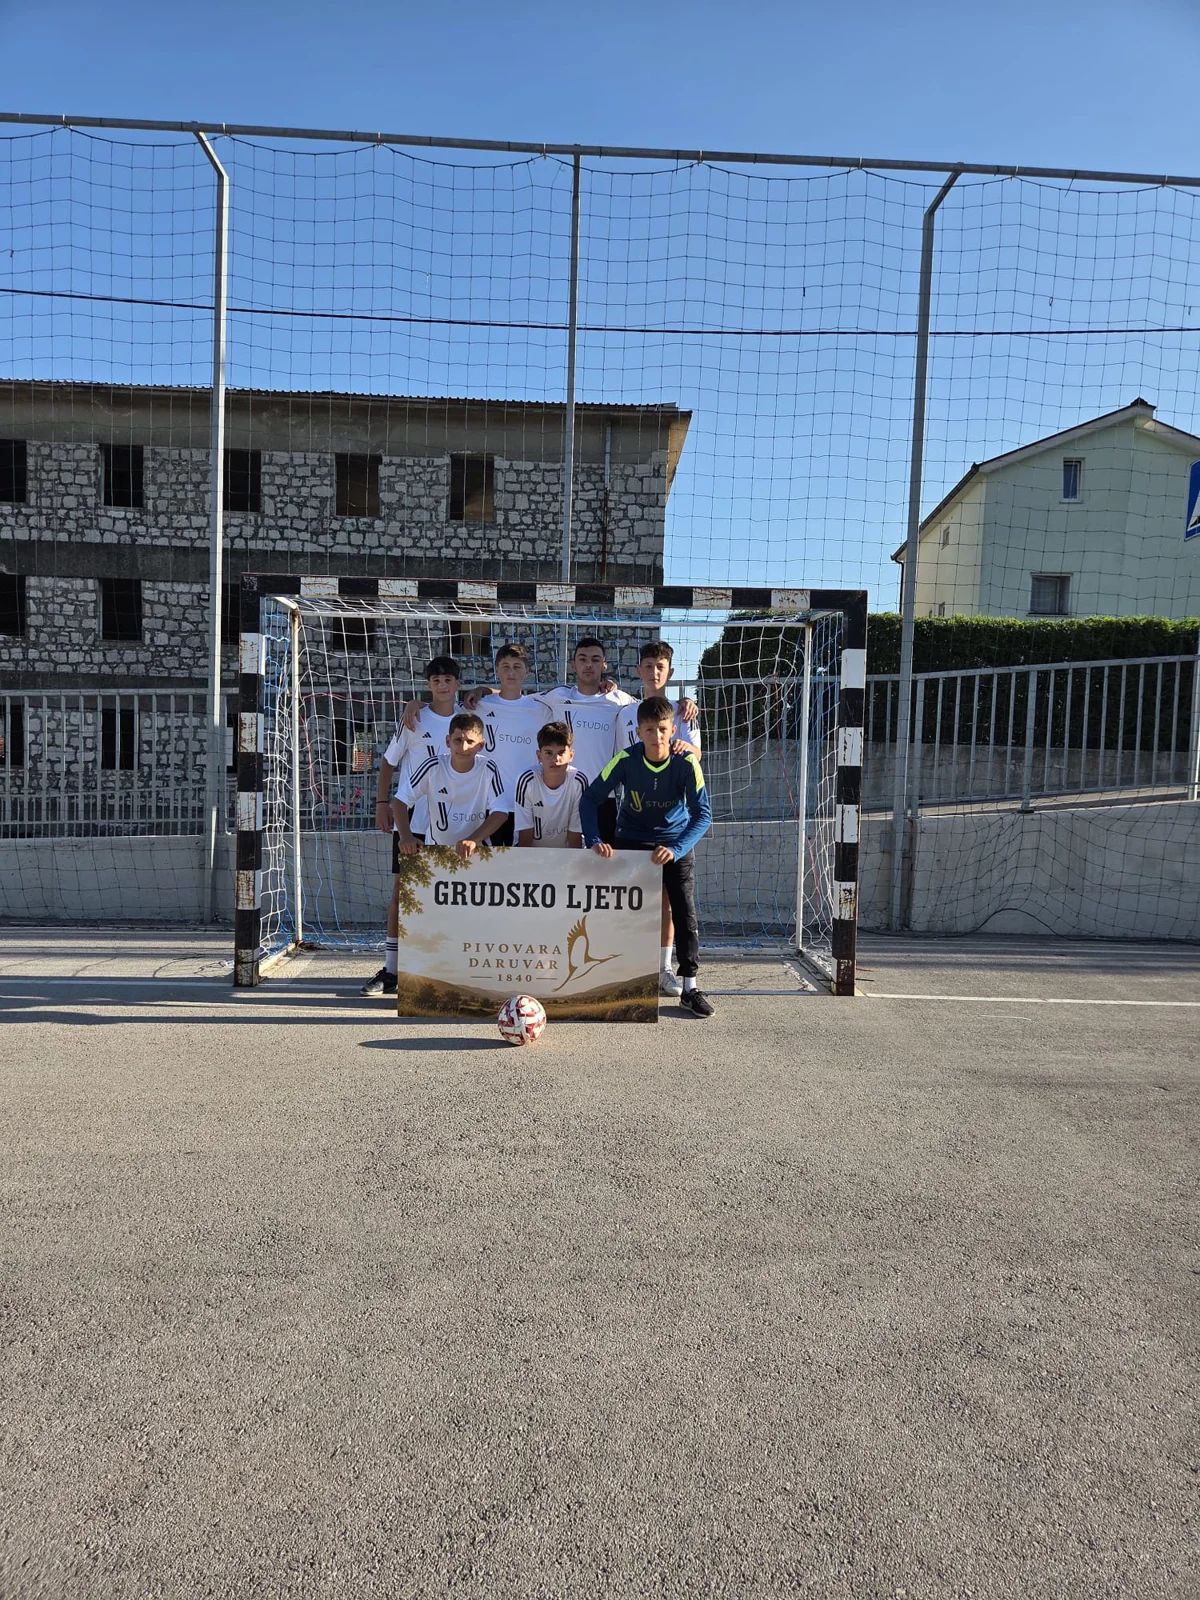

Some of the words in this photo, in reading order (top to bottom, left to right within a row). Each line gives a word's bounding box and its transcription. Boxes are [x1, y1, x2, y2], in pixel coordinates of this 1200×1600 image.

[576, 720, 610, 732] STUDIO
[499, 733, 532, 745] STUDIO
[645, 800, 677, 808] STUDI
[452, 811, 486, 822] STUDIO
[545, 826, 569, 836] STUD
[434, 880, 556, 909] GRUDSKO
[566, 884, 643, 914] LJETO
[463, 942, 562, 955] PIVOVARA
[469, 957, 559, 970] DARUVAR
[497, 973, 533, 983] 1840
